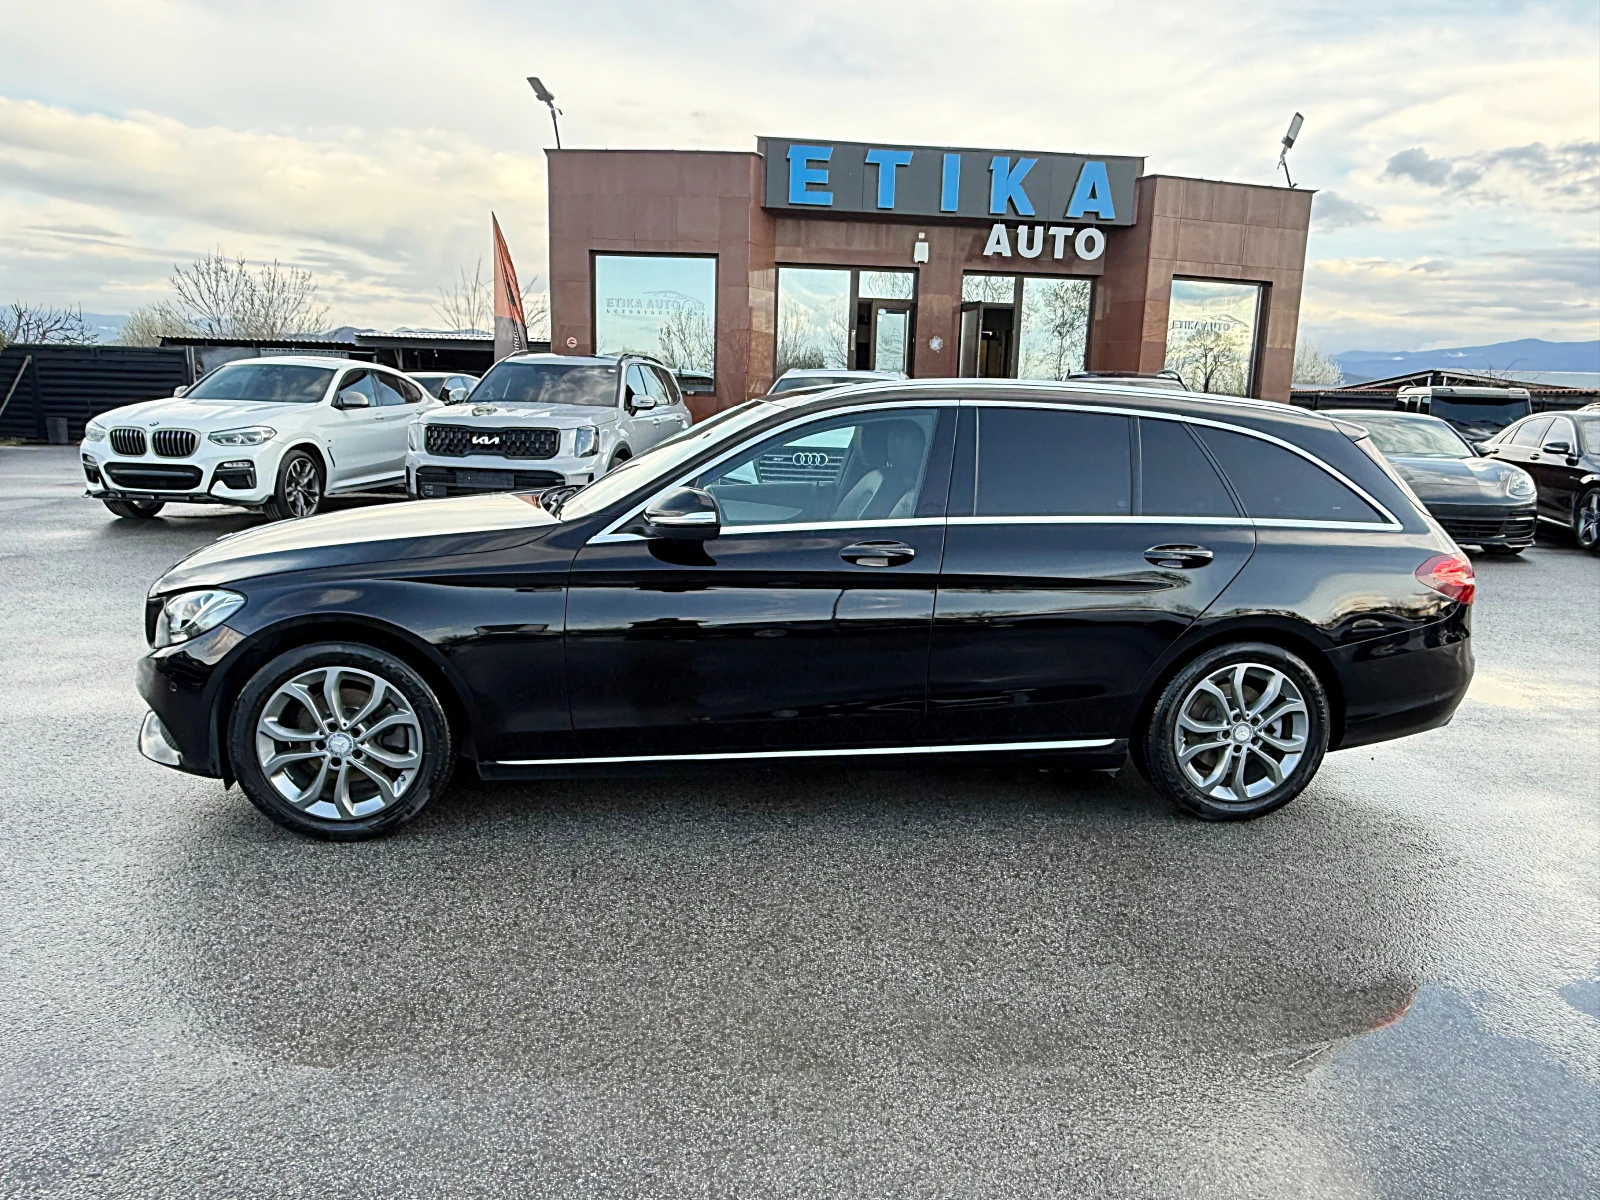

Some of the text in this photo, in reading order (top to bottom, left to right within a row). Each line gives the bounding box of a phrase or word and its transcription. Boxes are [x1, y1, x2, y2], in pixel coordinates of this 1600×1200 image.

[787, 144, 1115, 220] ETIKA
[983, 224, 1105, 261] AUTO
[606, 298, 681, 310] ETIKA AUTO
